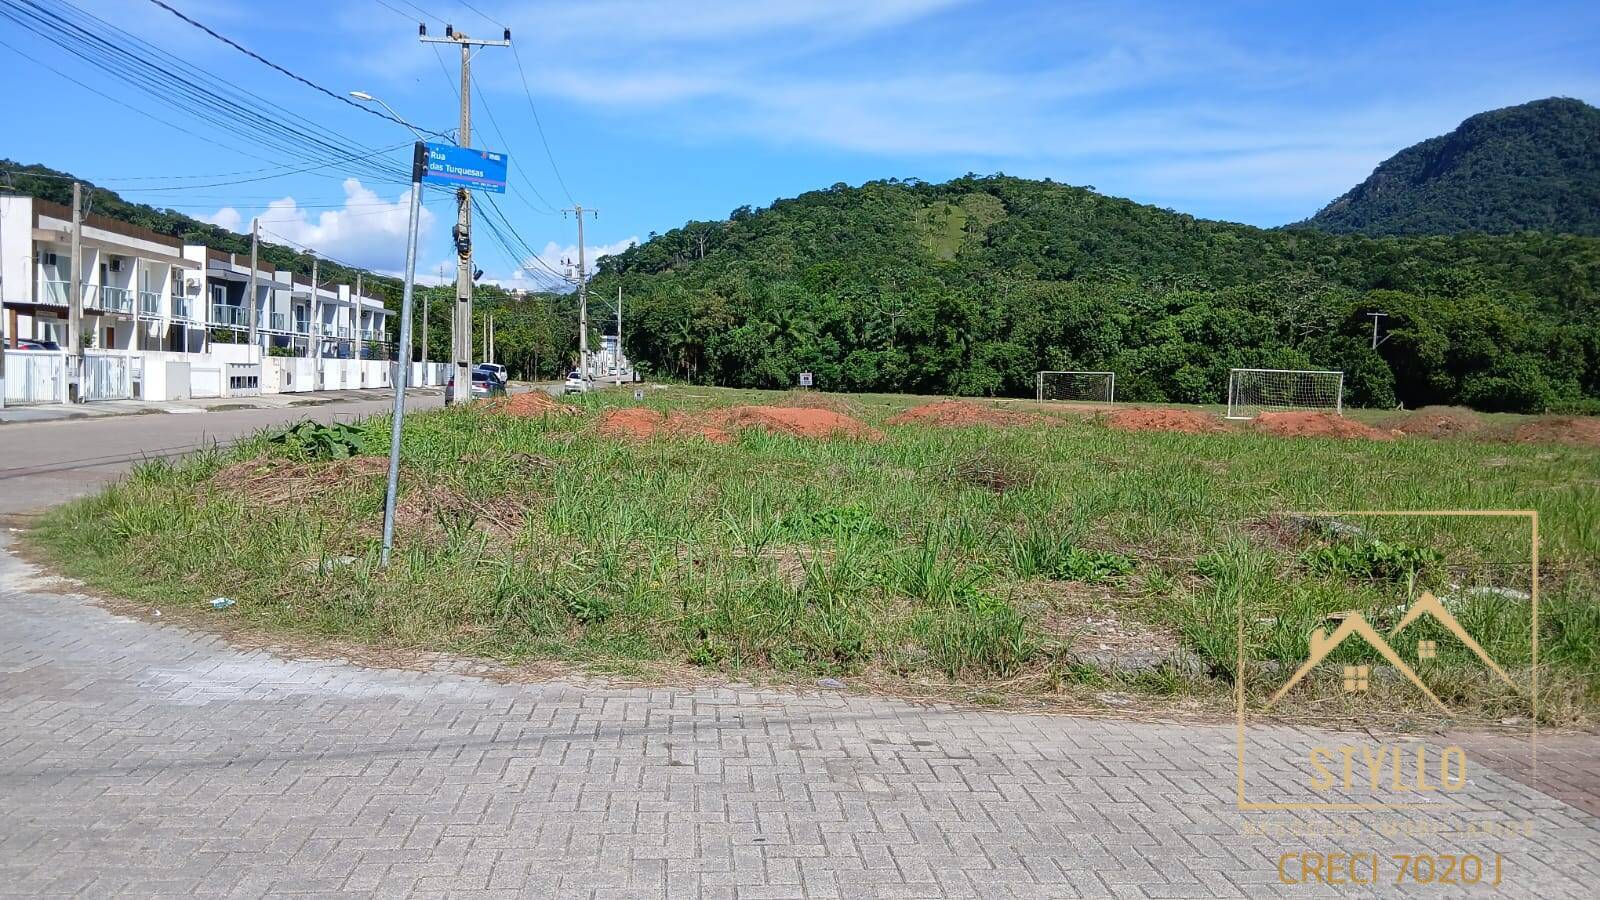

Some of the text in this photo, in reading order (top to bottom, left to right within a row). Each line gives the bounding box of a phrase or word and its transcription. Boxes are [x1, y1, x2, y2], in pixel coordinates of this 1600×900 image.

[430, 151, 446, 161] Rua
[429, 162, 484, 178] das Turquesas
